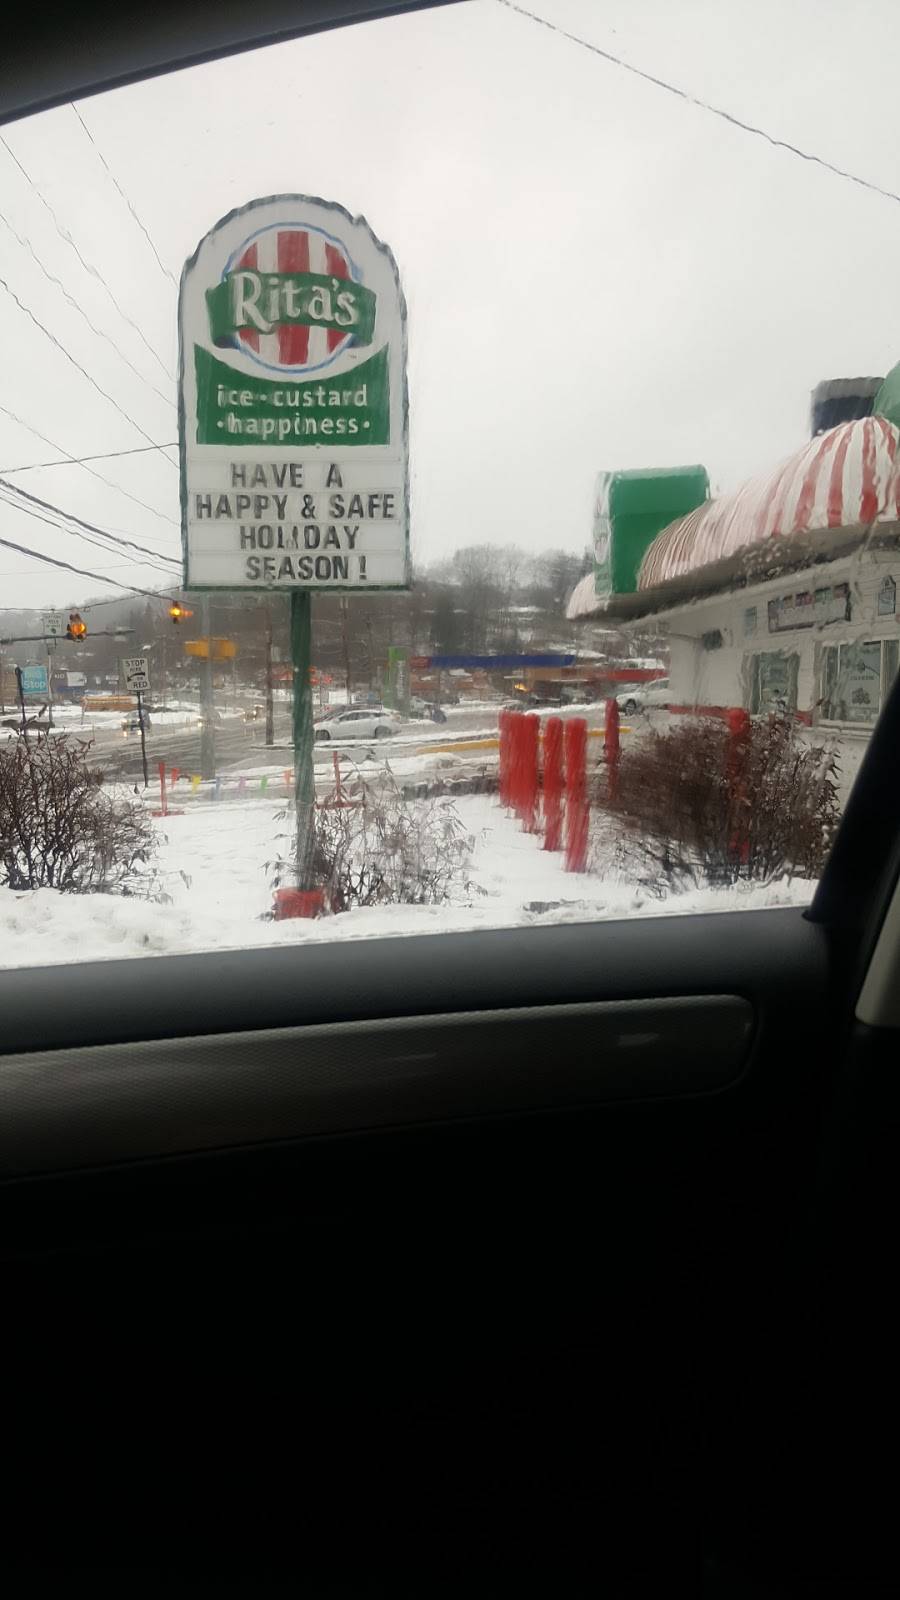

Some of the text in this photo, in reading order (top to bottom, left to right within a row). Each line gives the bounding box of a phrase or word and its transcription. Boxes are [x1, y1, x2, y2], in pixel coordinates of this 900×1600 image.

[231, 271, 360, 333] Rita's
[217, 384, 368, 407] ice custard
[227, 411, 360, 441] happiness
[231, 463, 343, 488] HAVE A
[195, 494, 395, 520] HAPPY & SAFE
[239, 524, 360, 550] HOLIDAY
[23, 680, 46, 690] Stop
